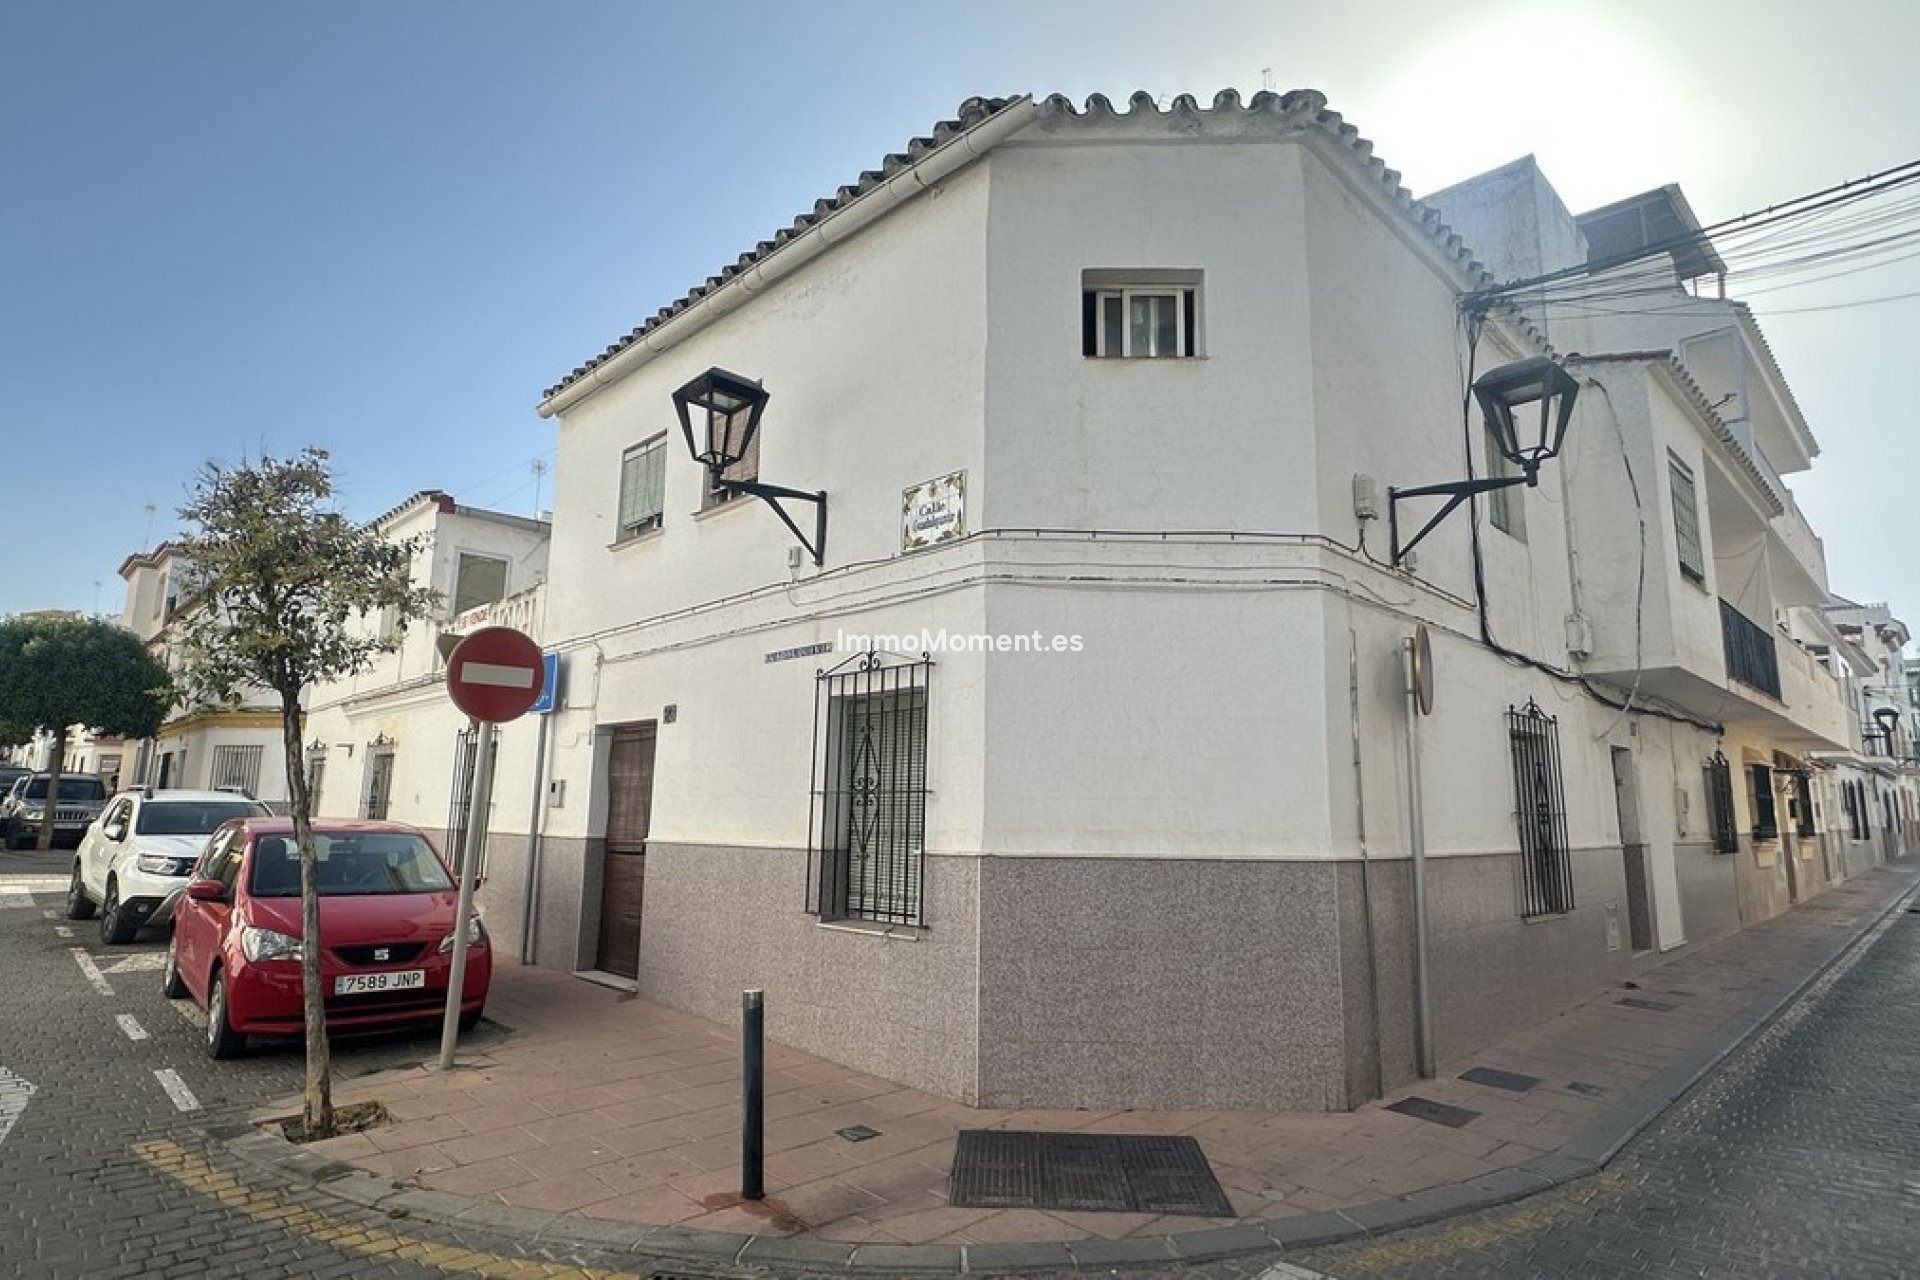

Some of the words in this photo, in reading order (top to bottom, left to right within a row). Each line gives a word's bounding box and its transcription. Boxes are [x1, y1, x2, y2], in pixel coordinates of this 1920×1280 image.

[918, 501, 946, 517] Calle
[346, 974, 387, 991] 7589
[392, 971, 421, 987] JNP
